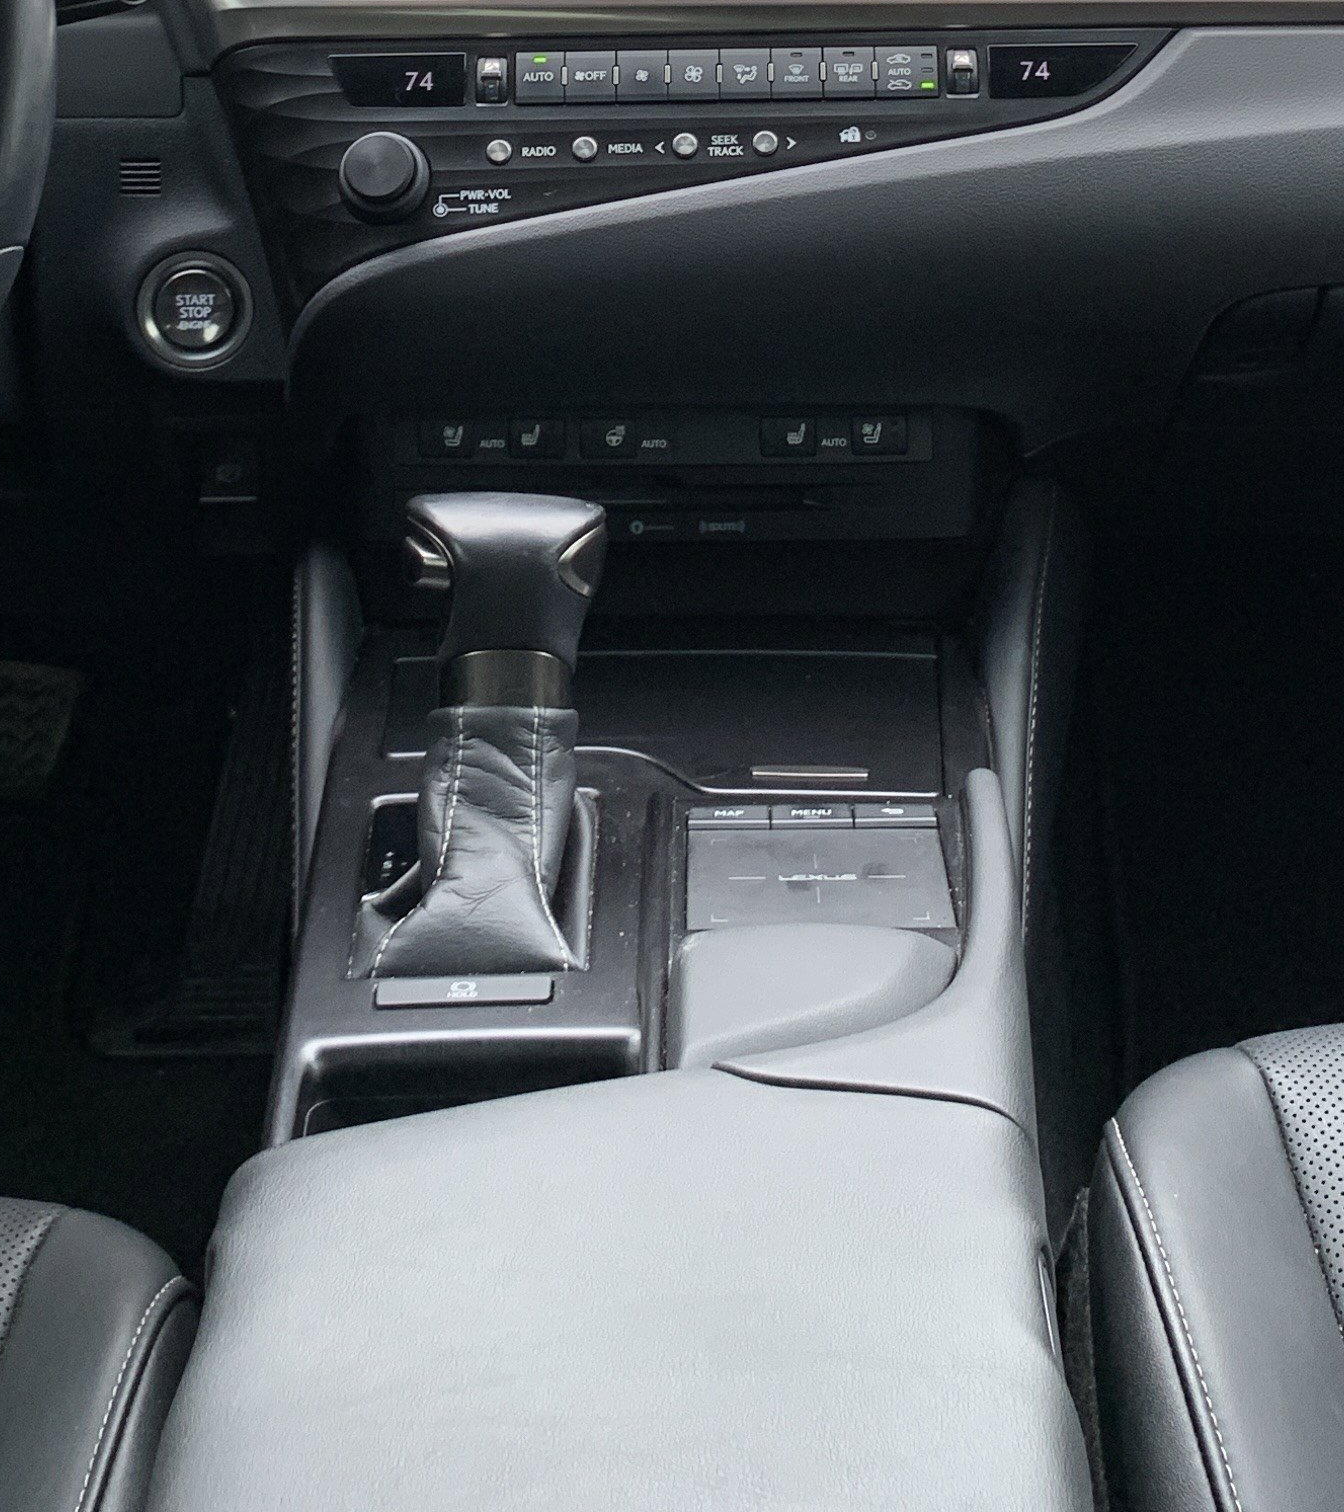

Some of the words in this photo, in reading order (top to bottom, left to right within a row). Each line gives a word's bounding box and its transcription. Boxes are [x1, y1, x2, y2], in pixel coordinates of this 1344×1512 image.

[522, 71, 555, 83] AUTO
[585, 70, 608, 82] OFF
[887, 67, 912, 77] AUTO
[1019, 60, 1051, 82] 74
[404, 71, 435, 92] 74
[783, 74, 810, 84] FRONT
[838, 73, 859, 83] REAR
[711, 134, 739, 146] SEEK
[521, 145, 557, 158] RADIO
[608, 143, 644, 155] MEDIA
[707, 146, 745, 158] TRACK
[468, 203, 500, 215] TUNE
[175, 293, 216, 307] START
[179, 306, 213, 319] STOP
[478, 438, 506, 450] AUTO
[640, 438, 668, 449] AUTO
[820, 436, 848, 448] AUTO
[713, 809, 745, 818] MAP
[790, 808, 833, 817] MENU
[777, 873, 858, 882] LEXUS
